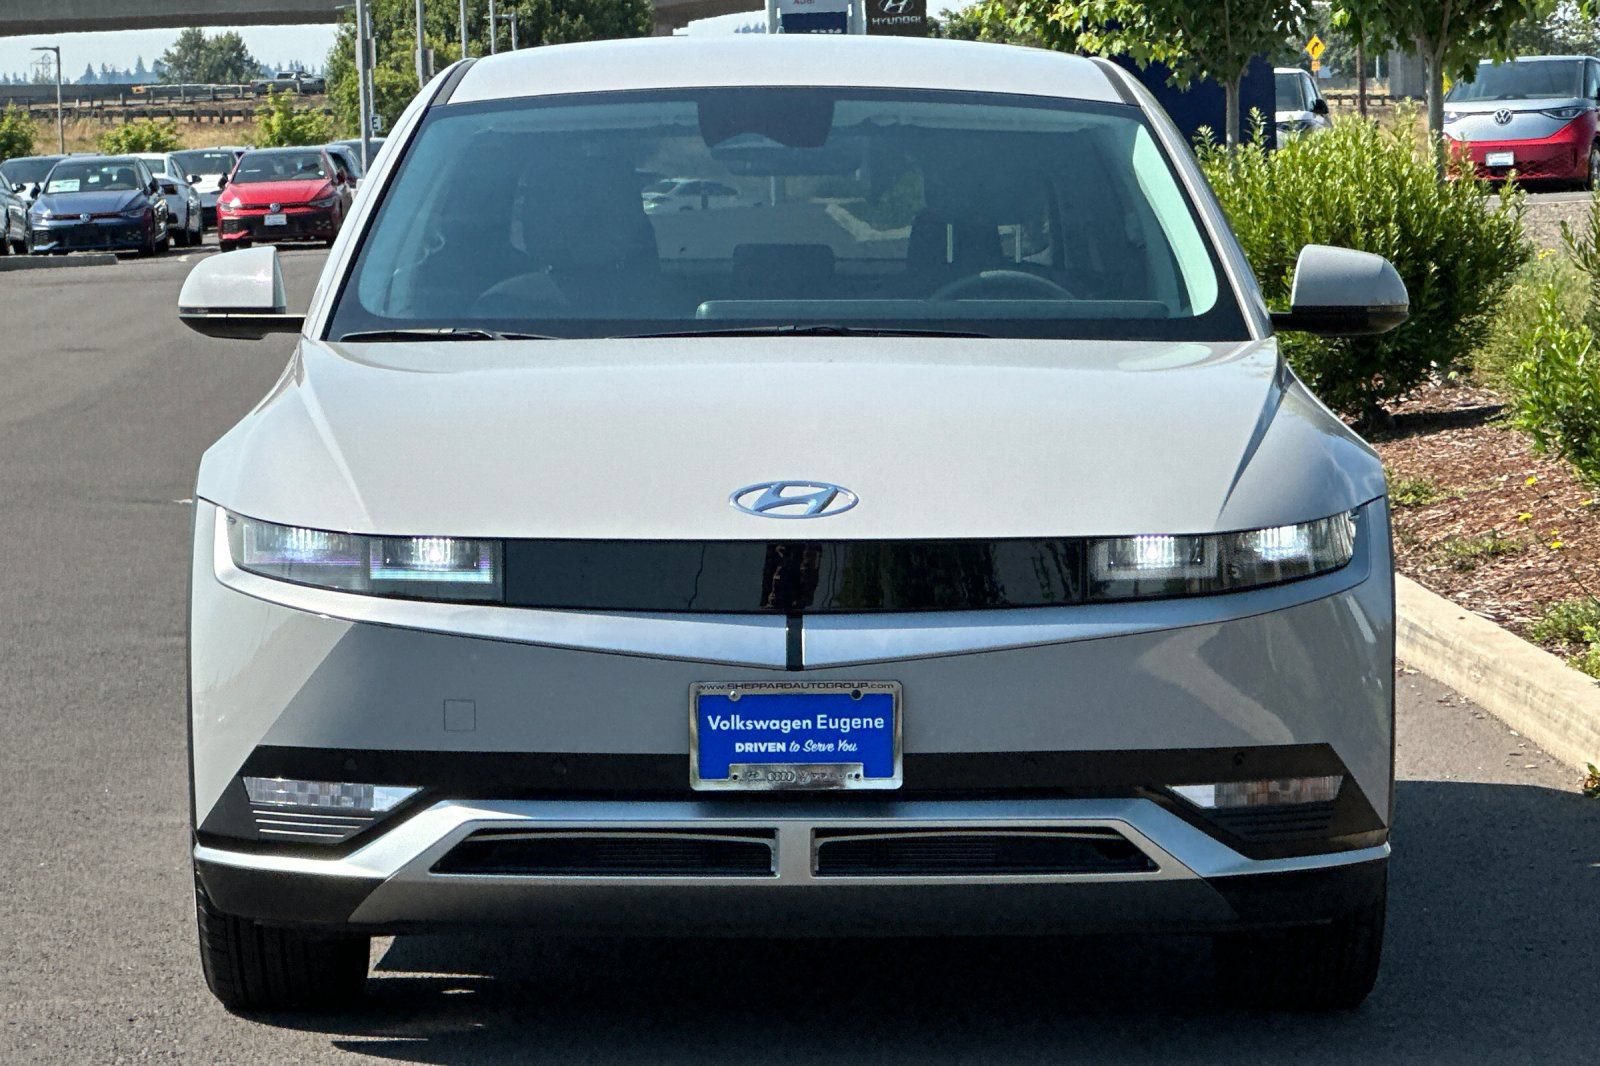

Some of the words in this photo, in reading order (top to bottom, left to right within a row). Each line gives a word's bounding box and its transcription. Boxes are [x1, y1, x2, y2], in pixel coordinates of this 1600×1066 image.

[872, 15, 922, 25] HYUNDAI
[699, 682, 894, 690] www.SHEPPARDAUTOGROUP.com
[707, 714, 812, 733] Volkswagen
[816, 714, 884, 733] Eugene
[735, 742, 787, 753] DRIVEN
[789, 740, 801, 752] to
[802, 739, 835, 753] Serve
[837, 739, 858, 752] You
